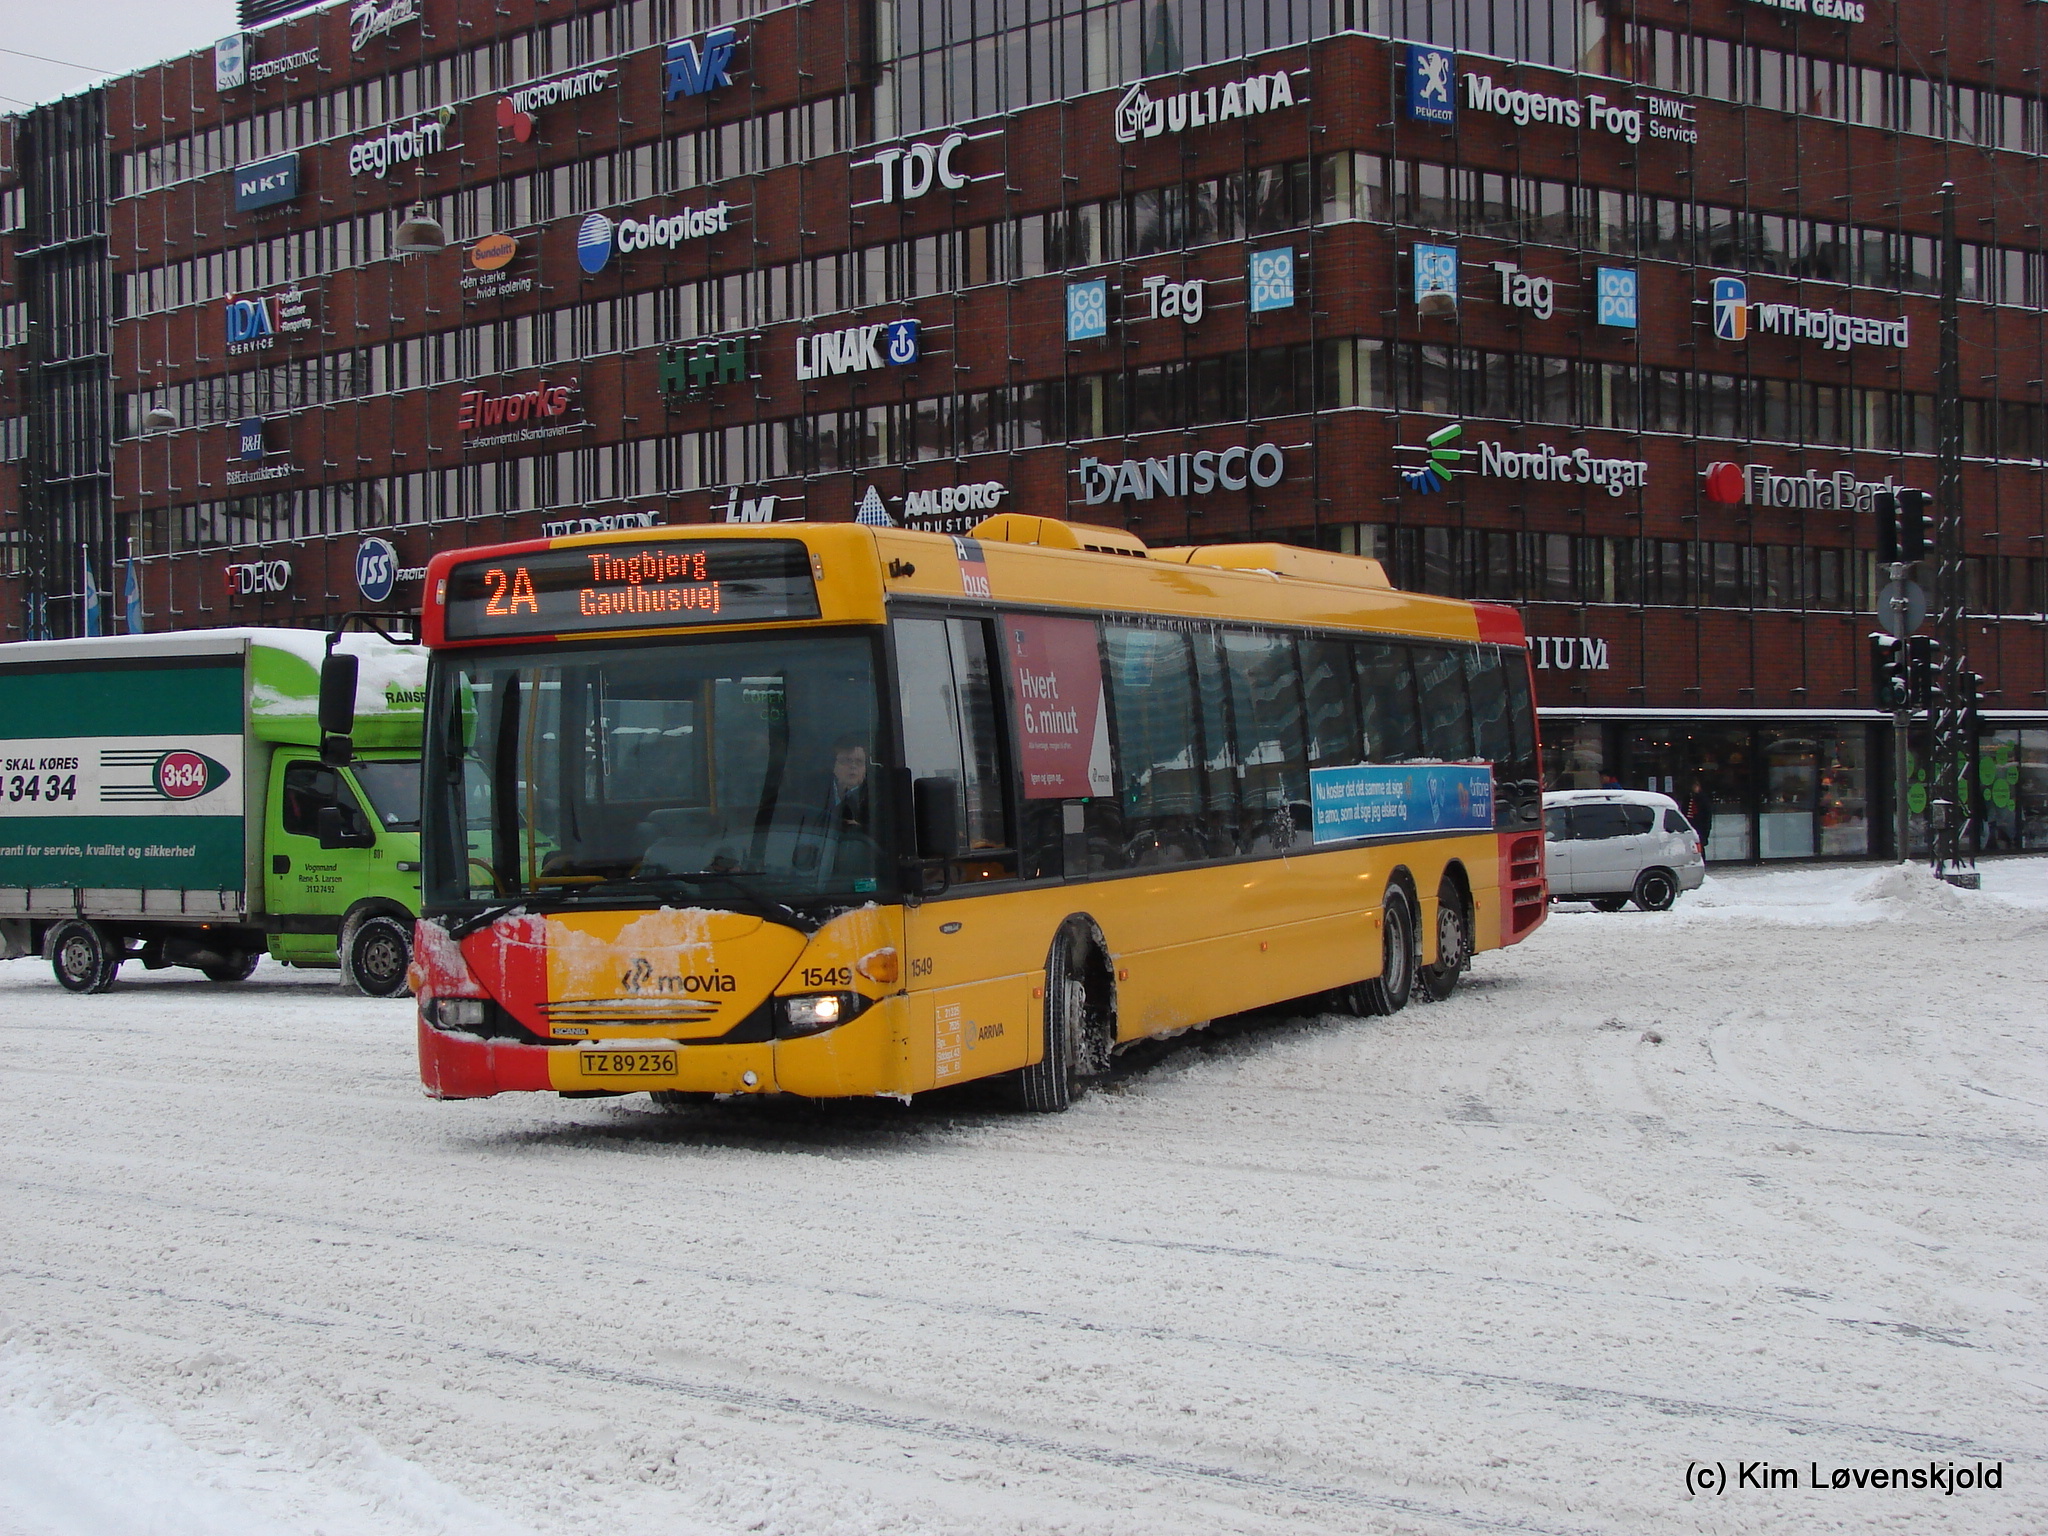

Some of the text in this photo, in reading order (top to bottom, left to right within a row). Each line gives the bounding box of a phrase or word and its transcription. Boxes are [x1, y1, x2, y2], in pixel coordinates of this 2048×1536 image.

[1812, 0, 1865, 23] GEARS
[218, 73, 243, 90] SAM
[512, 71, 606, 114] MICRO MATIC
[1145, 70, 1294, 139] JULIANA
[1415, 107, 1453, 121] PEUGEOT
[1464, 73, 1642, 144] Mogens Fog
[1649, 97, 1684, 119] BMW
[1649, 120, 1698, 144] Service
[350, 117, 443, 180] eegholm
[875, 132, 967, 204] TDC
[241, 171, 290, 197] NKT
[618, 200, 729, 253] Coloplast
[1253, 252, 1290, 281] ico
[476, 277, 532, 300] hvide isolering
[1070, 285, 1104, 312] ico
[1143, 274, 1204, 324] Tag
[1492, 261, 1553, 320] Tag
[230, 337, 274, 356] SERVICE
[797, 325, 884, 381] LINAK
[458, 379, 569, 430] Elworks
[242, 434, 262, 453] B&H
[1080, 443, 1284, 505] DANISCO
[1477, 440, 1648, 497] Nordic Sugar
[726, 486, 780, 523] LM
[904, 481, 1004, 518] AALBORG
[952, 535, 968, 560] A
[242, 560, 290, 594] DEKO
[361, 555, 389, 586] ISS
[396, 566, 427, 582] FACILI
[587, 550, 707, 584] Tingbjerg
[484, 567, 539, 616] 2A
[961, 568, 990, 597] bus
[382, 691, 427, 704] RANSP
[1020, 668, 1059, 699] Hvert
[1025, 703, 1079, 734] 6. minut
[5, 758, 36, 771] SKAL
[39, 757, 79, 770] KØRES
[9, 775, 40, 802] 34
[45, 774, 77, 801] 34
[0, 844, 196, 858] ranti for service, kvalitet og sikkerhed
[658, 969, 736, 992] movia
[801, 967, 853, 986] 1549
[912, 957, 933, 977] 1549
[554, 1028, 588, 1036] SCANIA
[978, 1023, 1004, 1041] ARRIVA
[583, 1054, 674, 1072] TZ 89 236
